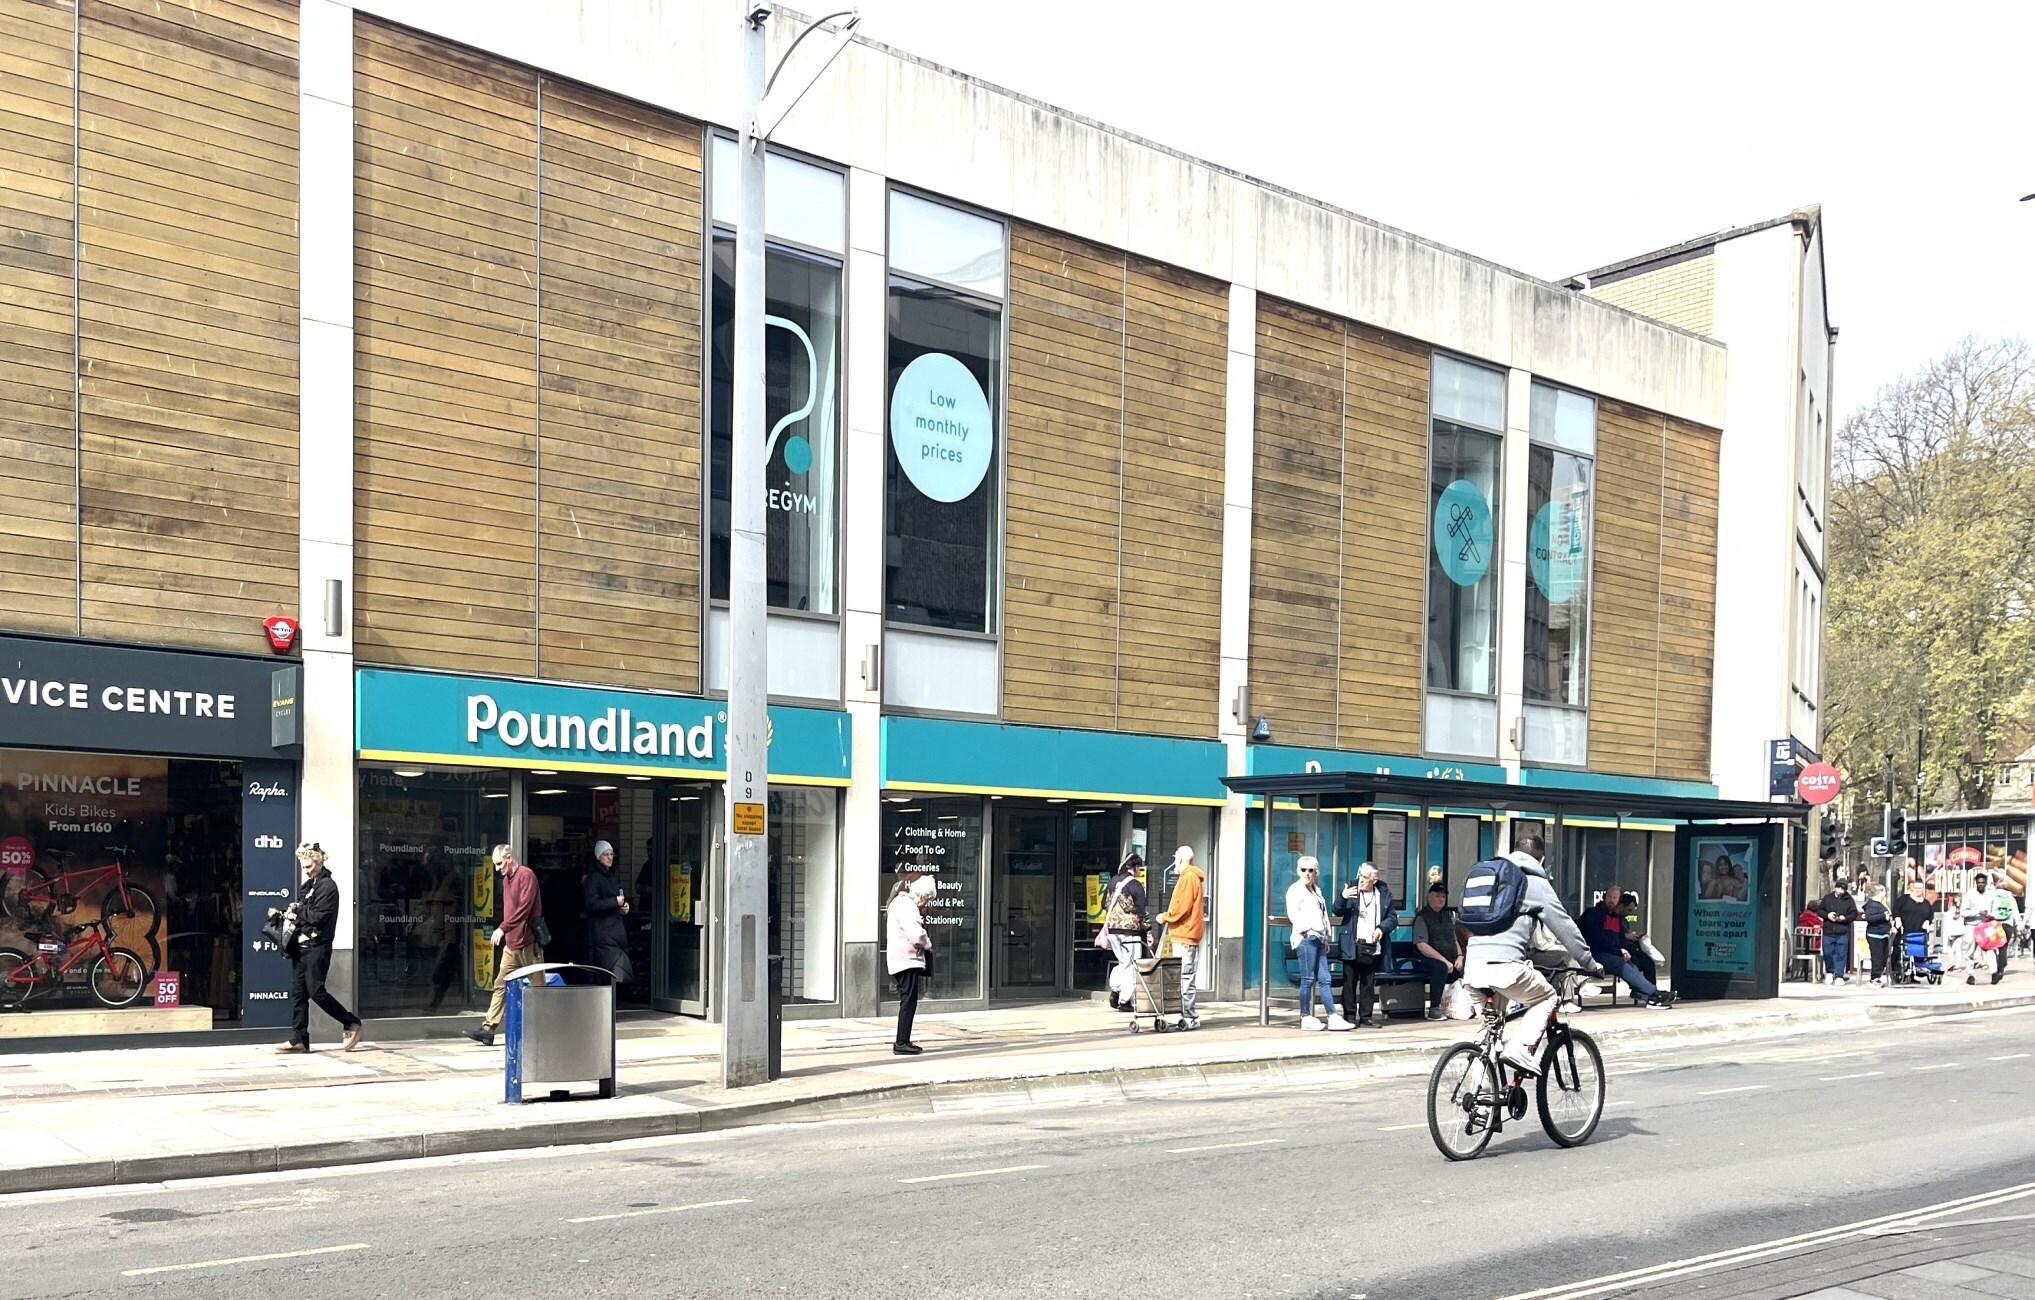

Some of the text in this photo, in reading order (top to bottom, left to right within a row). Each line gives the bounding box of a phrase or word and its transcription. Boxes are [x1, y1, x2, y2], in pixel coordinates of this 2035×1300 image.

[930, 389, 956, 409] Low
[916, 416, 969, 442] monthly
[921, 442, 962, 463] prices
[766, 488, 816, 515] EGYM
[1, 677, 236, 719] VICE CENTRE
[272, 698, 295, 708] EVANS
[467, 694, 714, 759] Poundland
[1801, 770, 1836, 785] COSTA
[17, 772, 141, 796] PINNACLE
[45, 803, 117, 818] Kids Bikes
[49, 820, 112, 833] From £160
[905, 827, 966, 839] Clothing & Home
[255, 835, 283, 848] dhb
[380, 843, 424, 853] Poundland
[444, 846, 486, 855] Poundland
[905, 845, 945, 855] Food To Go
[905, 863, 940, 872] Groceries
[938, 881, 962, 891] Beauty
[945, 898, 951, 907] &
[952, 898, 964, 907] Pet
[1694, 909, 1720, 917] When
[380, 914, 424, 923] Poundland
[444, 914, 487, 923] Poundland
[925, 916, 963, 926] Stationery
[1699, 919, 1721, 927] tears
[1696, 929, 1720, 937] teens
[157, 995, 177, 1003] OFF
[249, 992, 289, 1000] PINNACLE
